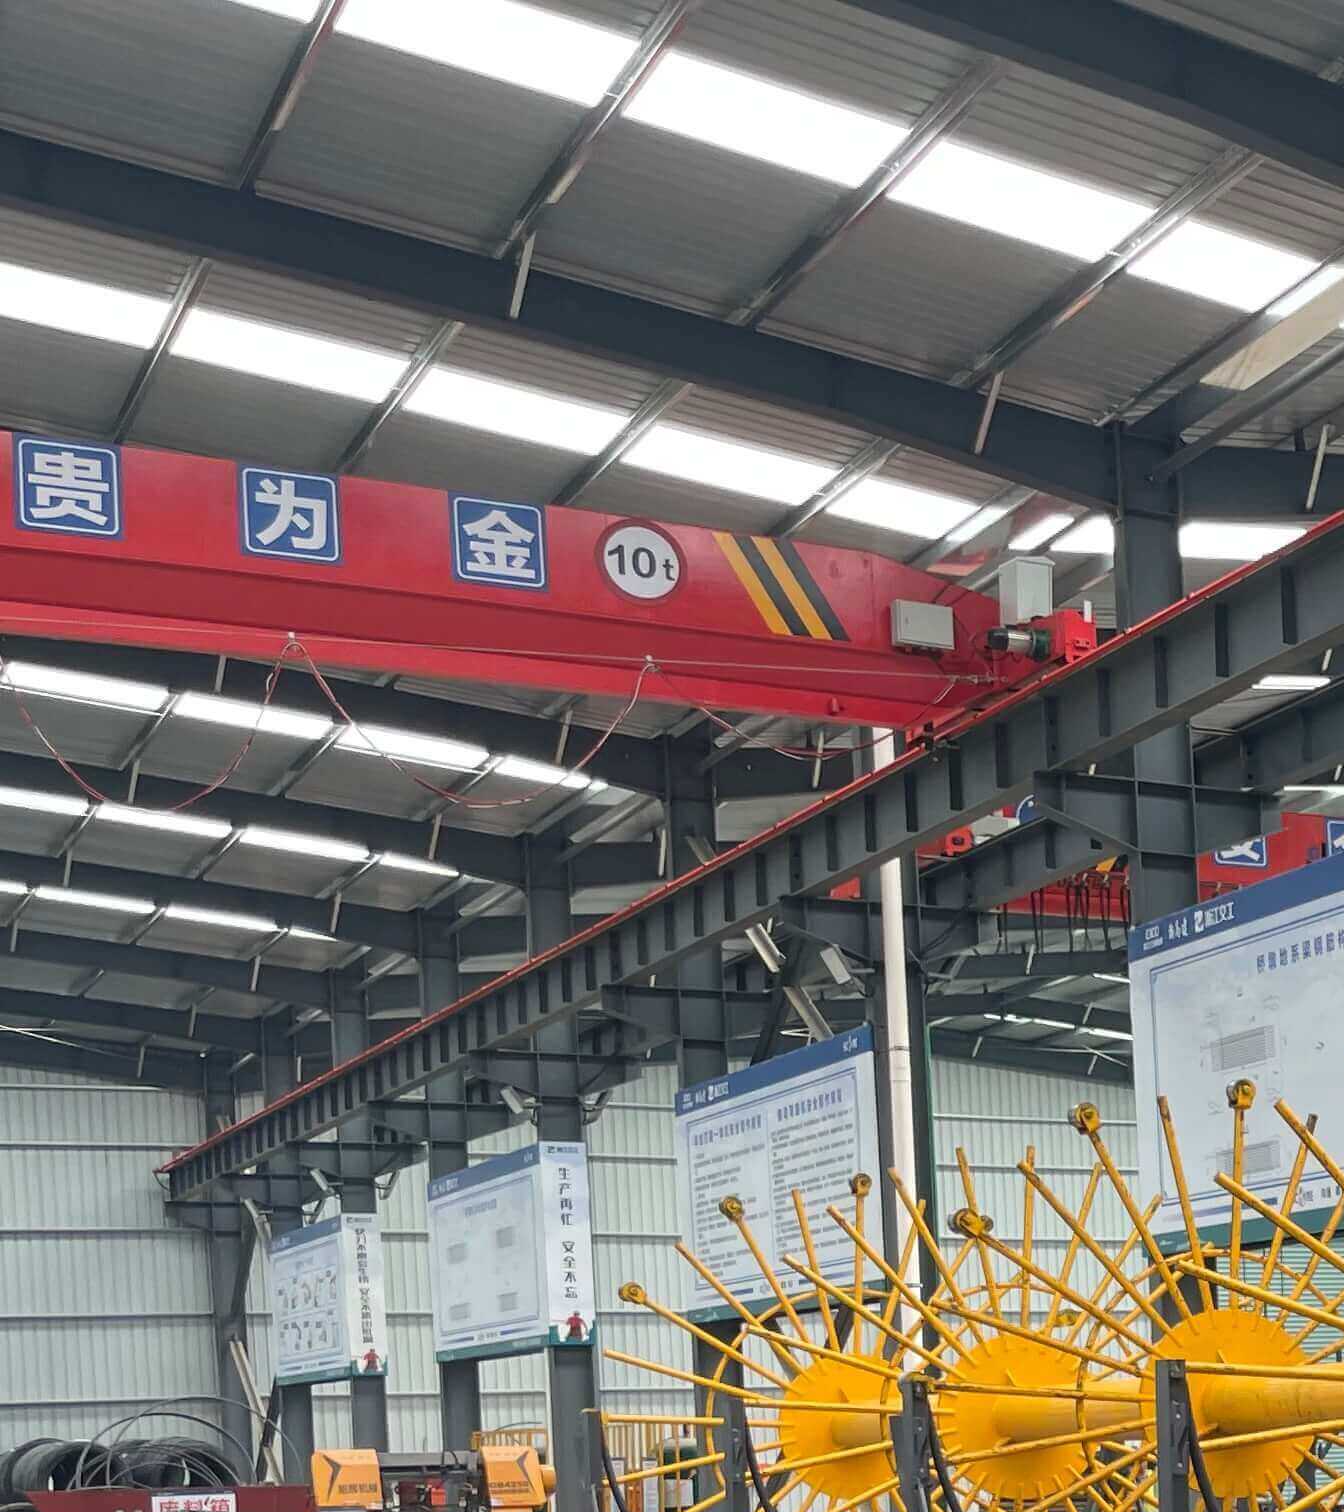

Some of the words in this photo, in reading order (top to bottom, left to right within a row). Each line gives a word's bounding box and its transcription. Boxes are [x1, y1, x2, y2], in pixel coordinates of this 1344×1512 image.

[27, 452, 110, 526] 贵
[254, 477, 326, 550] 为
[463, 509, 536, 580] 金
[607, 545, 675, 584] 10t
[557, 1166, 575, 1226] 生产再忙
[562, 1240, 579, 1299] 安全不忘
